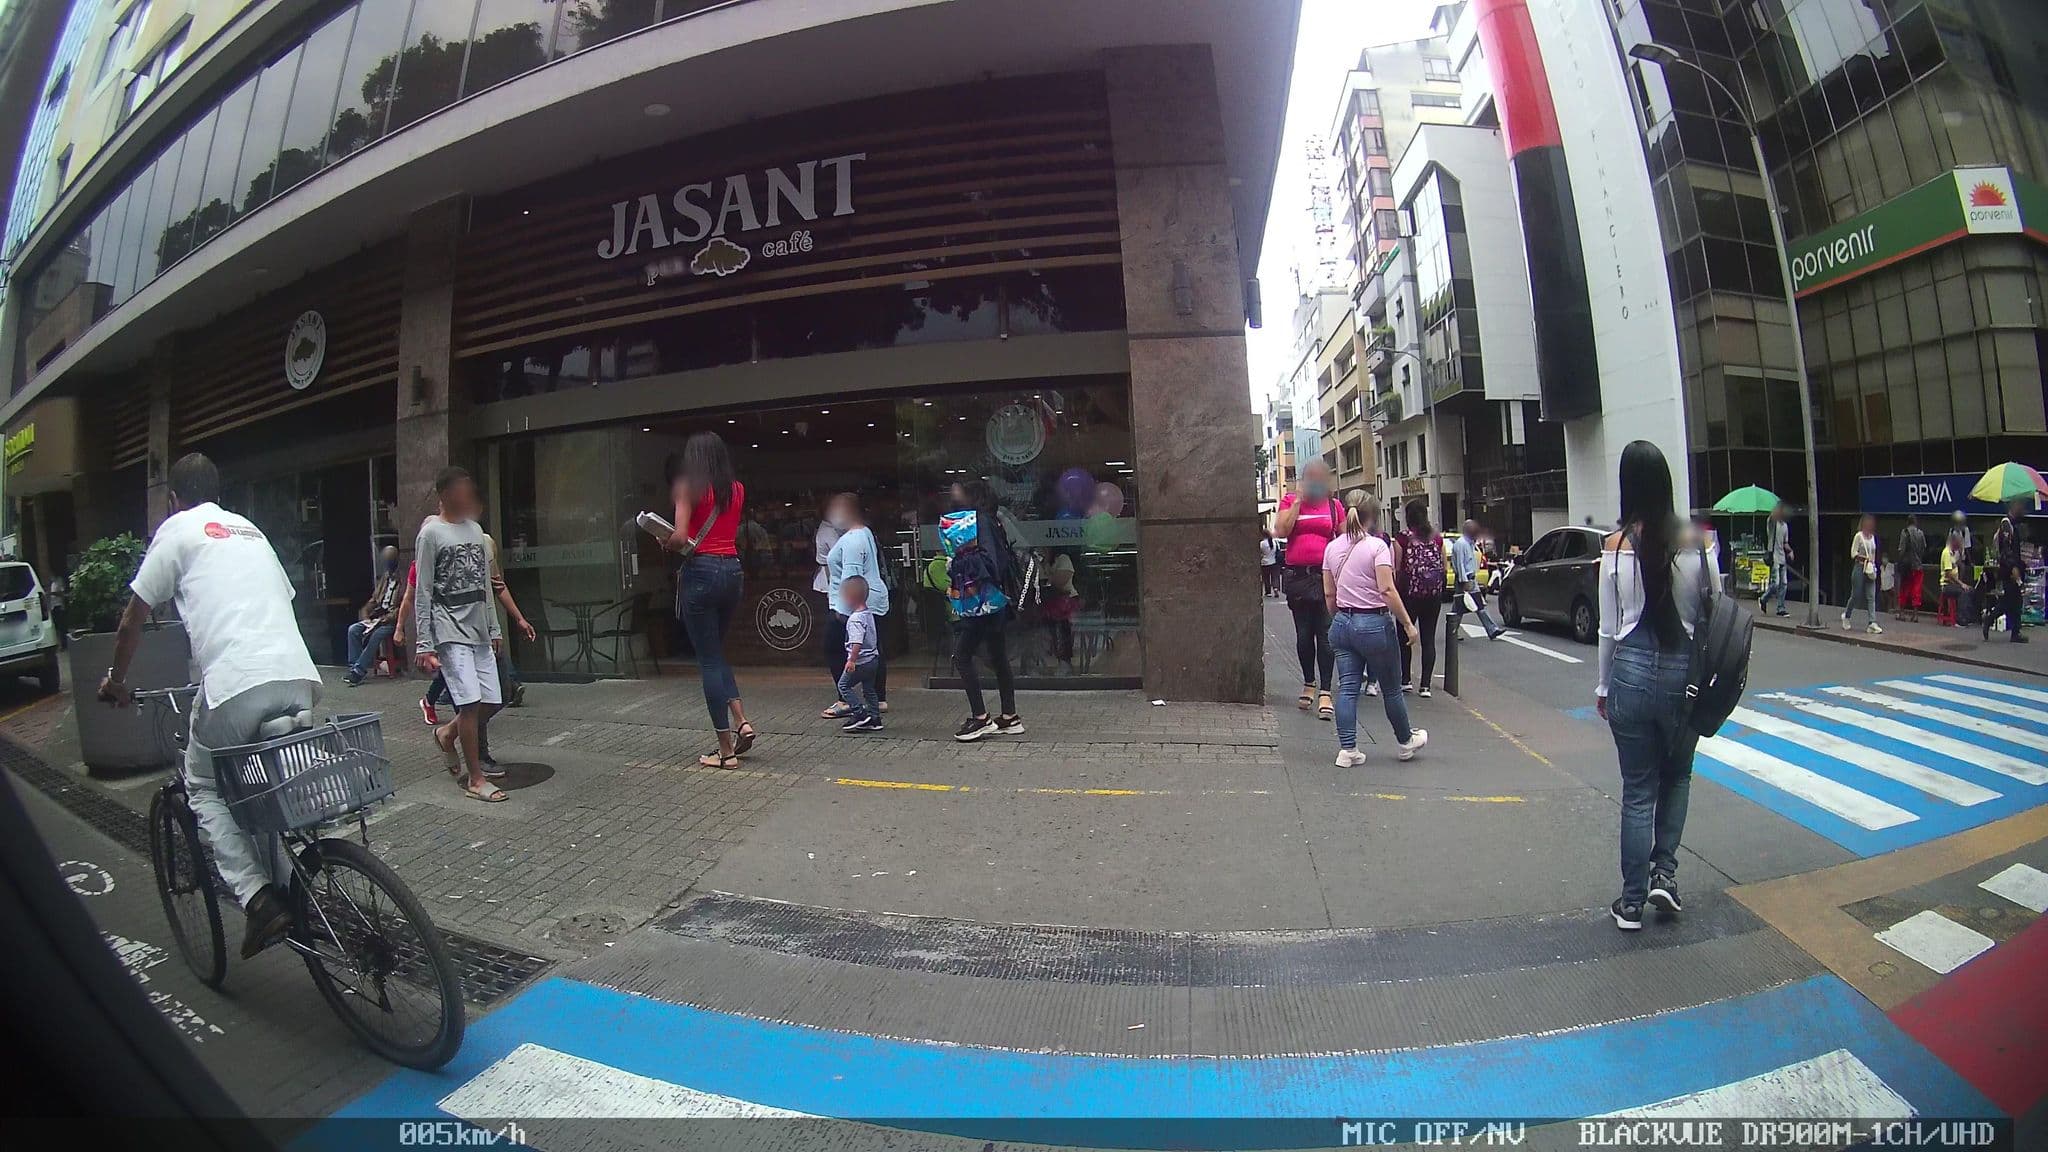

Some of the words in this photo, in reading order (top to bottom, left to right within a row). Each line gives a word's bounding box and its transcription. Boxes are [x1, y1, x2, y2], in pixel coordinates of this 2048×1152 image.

[597, 153, 866, 260] JASANT
[1970, 209, 2013, 223] porvenir
[762, 230, 814, 258] café
[1793, 224, 1874, 291] porvenir
[1908, 481, 1952, 505] BBVA
[761, 591, 805, 609] JASANT
